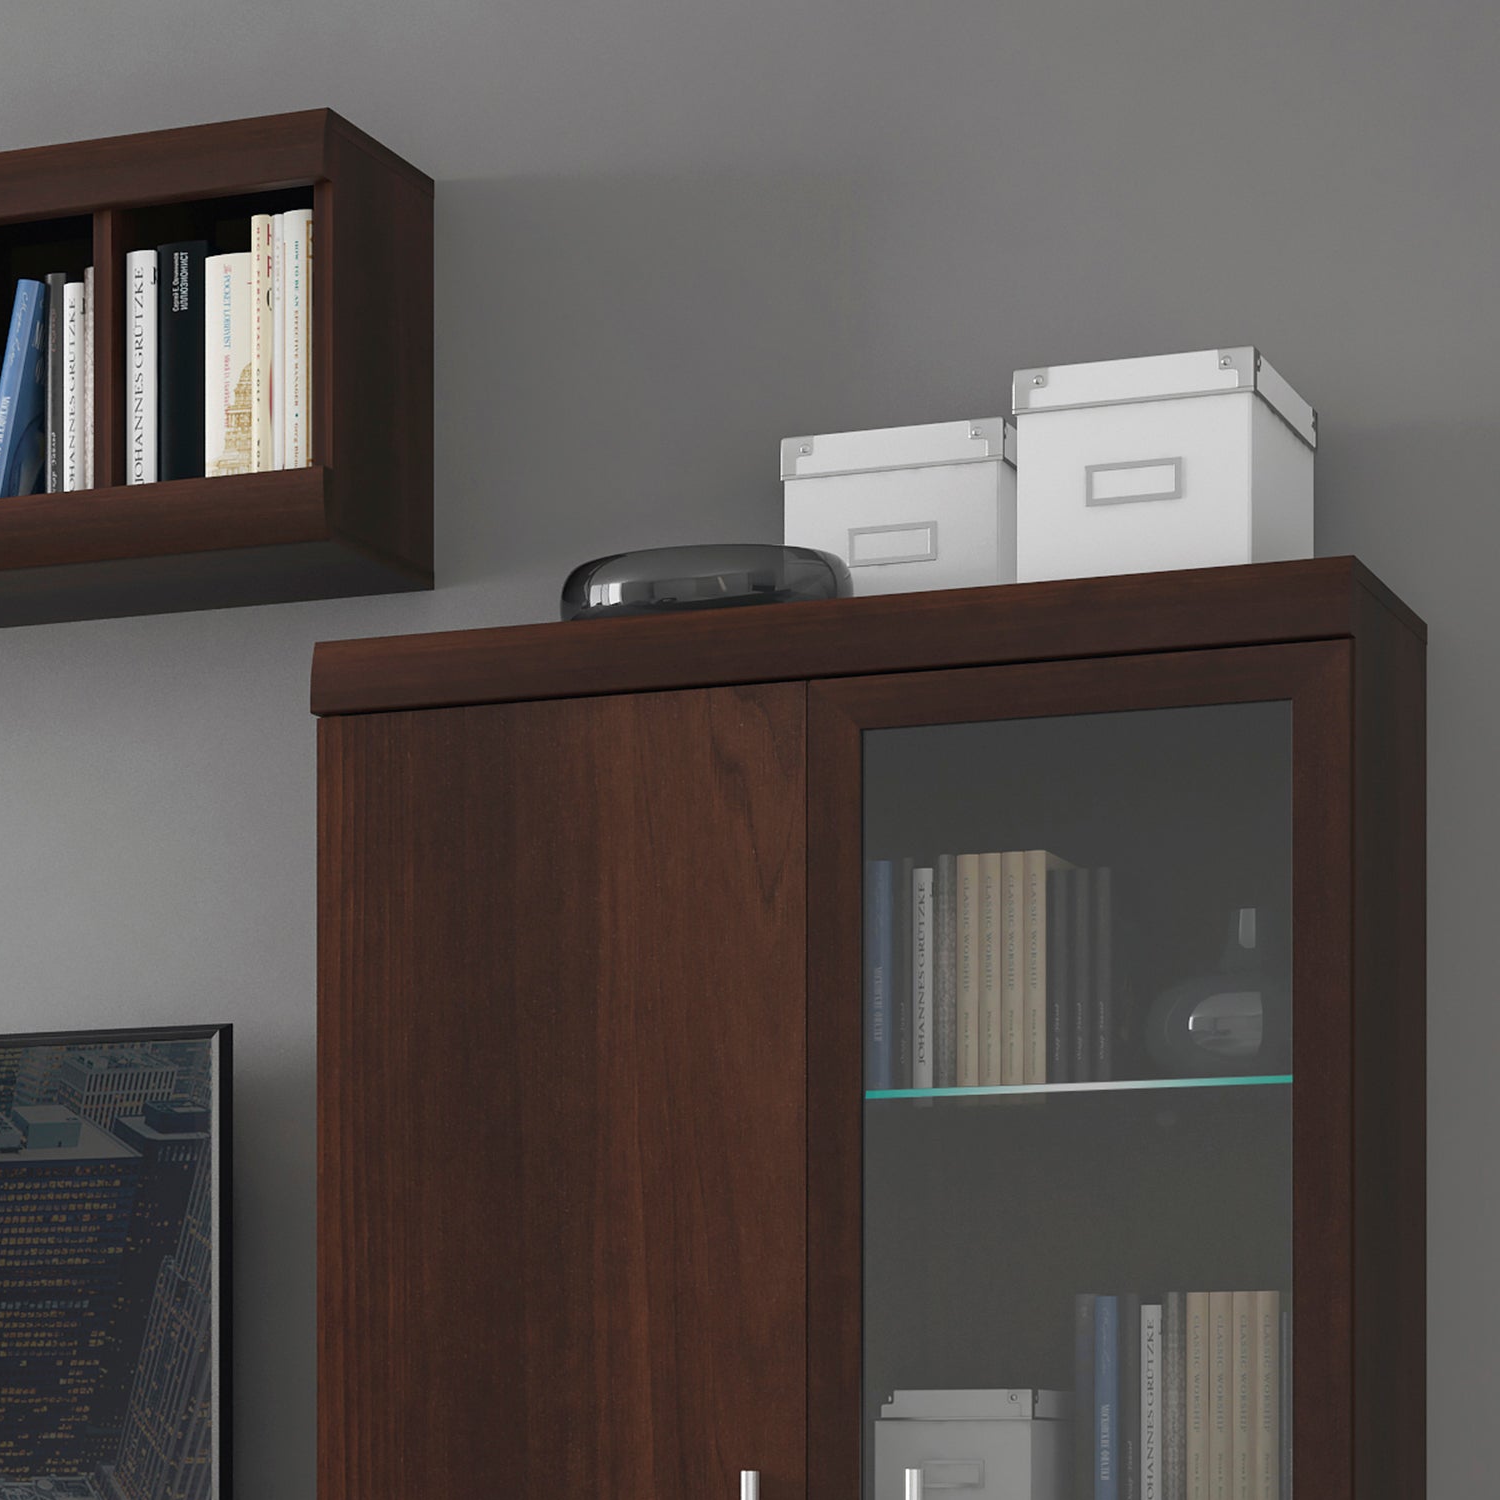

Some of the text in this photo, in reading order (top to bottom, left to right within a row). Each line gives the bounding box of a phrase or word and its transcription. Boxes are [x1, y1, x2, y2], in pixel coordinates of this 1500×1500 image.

[67, 395, 76, 491] OHANNES
[133, 371, 145, 485] JOHANNES
[917, 970, 926, 1065] JOHANNES
